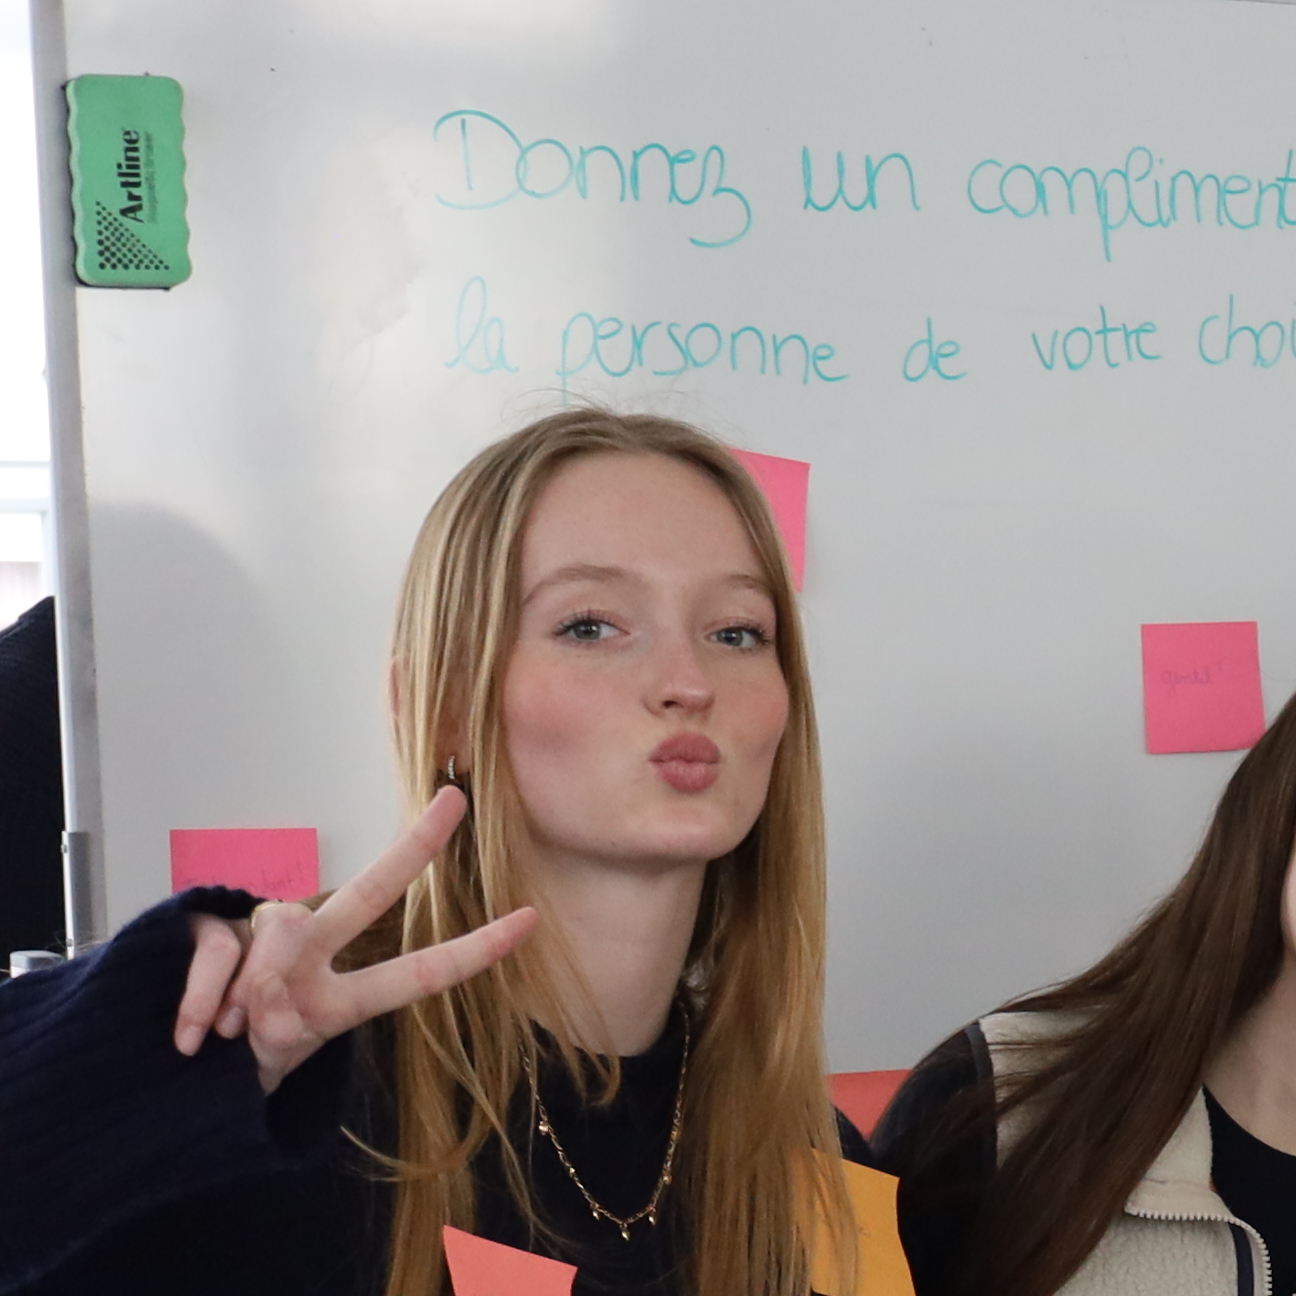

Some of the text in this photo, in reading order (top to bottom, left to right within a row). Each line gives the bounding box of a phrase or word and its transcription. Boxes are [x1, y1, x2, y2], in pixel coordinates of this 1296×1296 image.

[116, 129, 145, 224] Artline
[433, 109, 753, 249] Donnez
[801, 145, 921, 213] un
[443, 276, 519, 374] la
[555, 312, 850, 408] personne
[902, 316, 968, 383] de
[1031, 304, 1162, 372] votre
